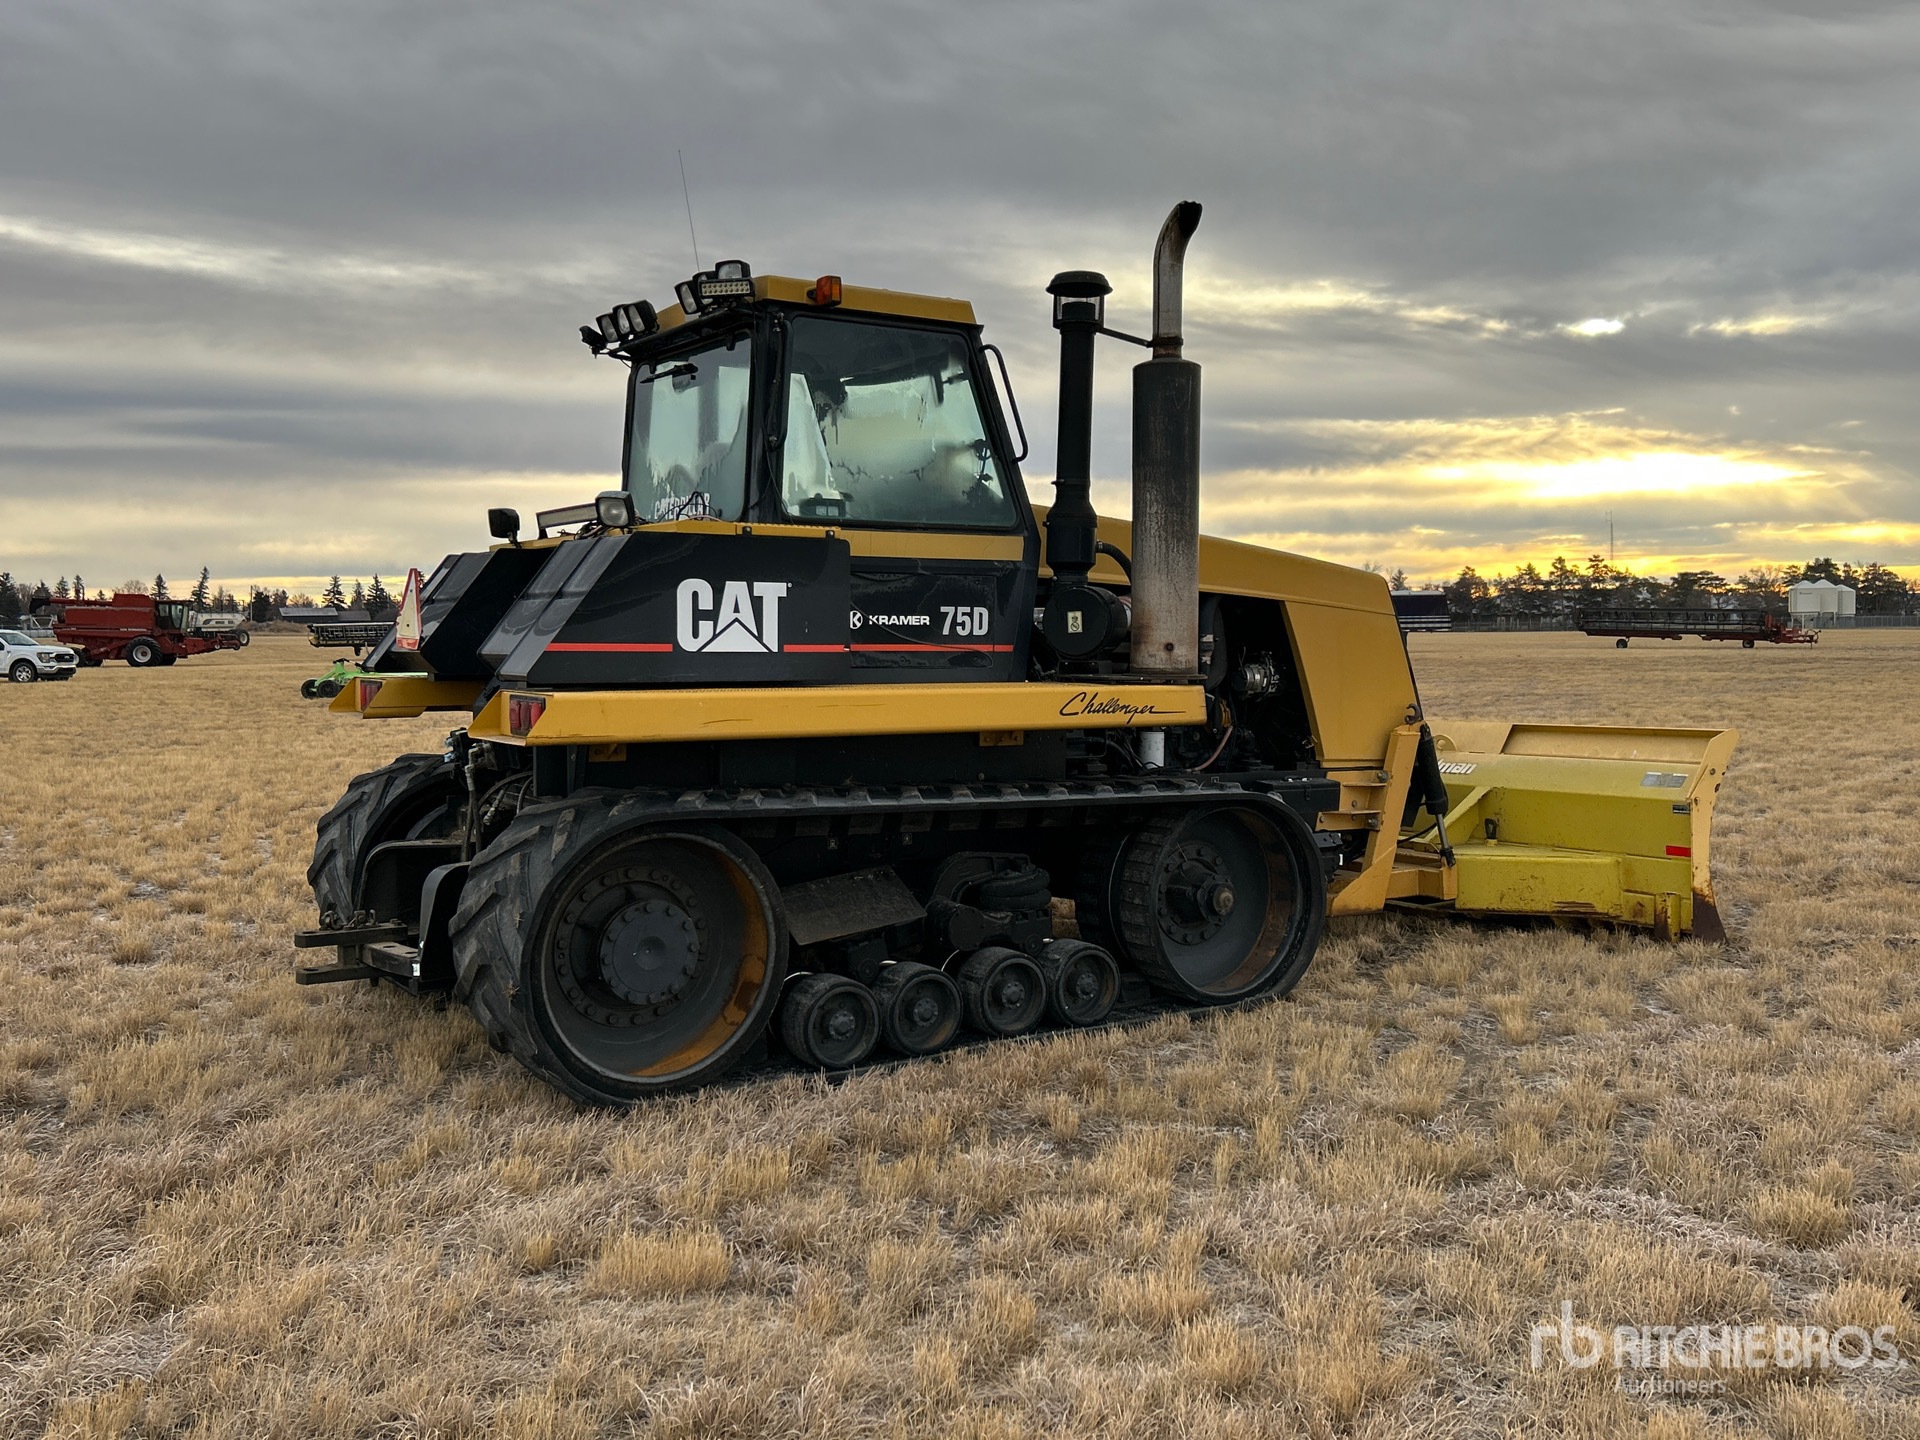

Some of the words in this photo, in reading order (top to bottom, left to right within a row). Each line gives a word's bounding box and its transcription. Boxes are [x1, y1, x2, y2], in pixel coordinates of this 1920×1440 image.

[676, 578, 788, 653] CAT
[868, 614, 930, 626] KRAMER
[940, 606, 990, 637] 75D
[1059, 691, 1187, 725] Challenger
